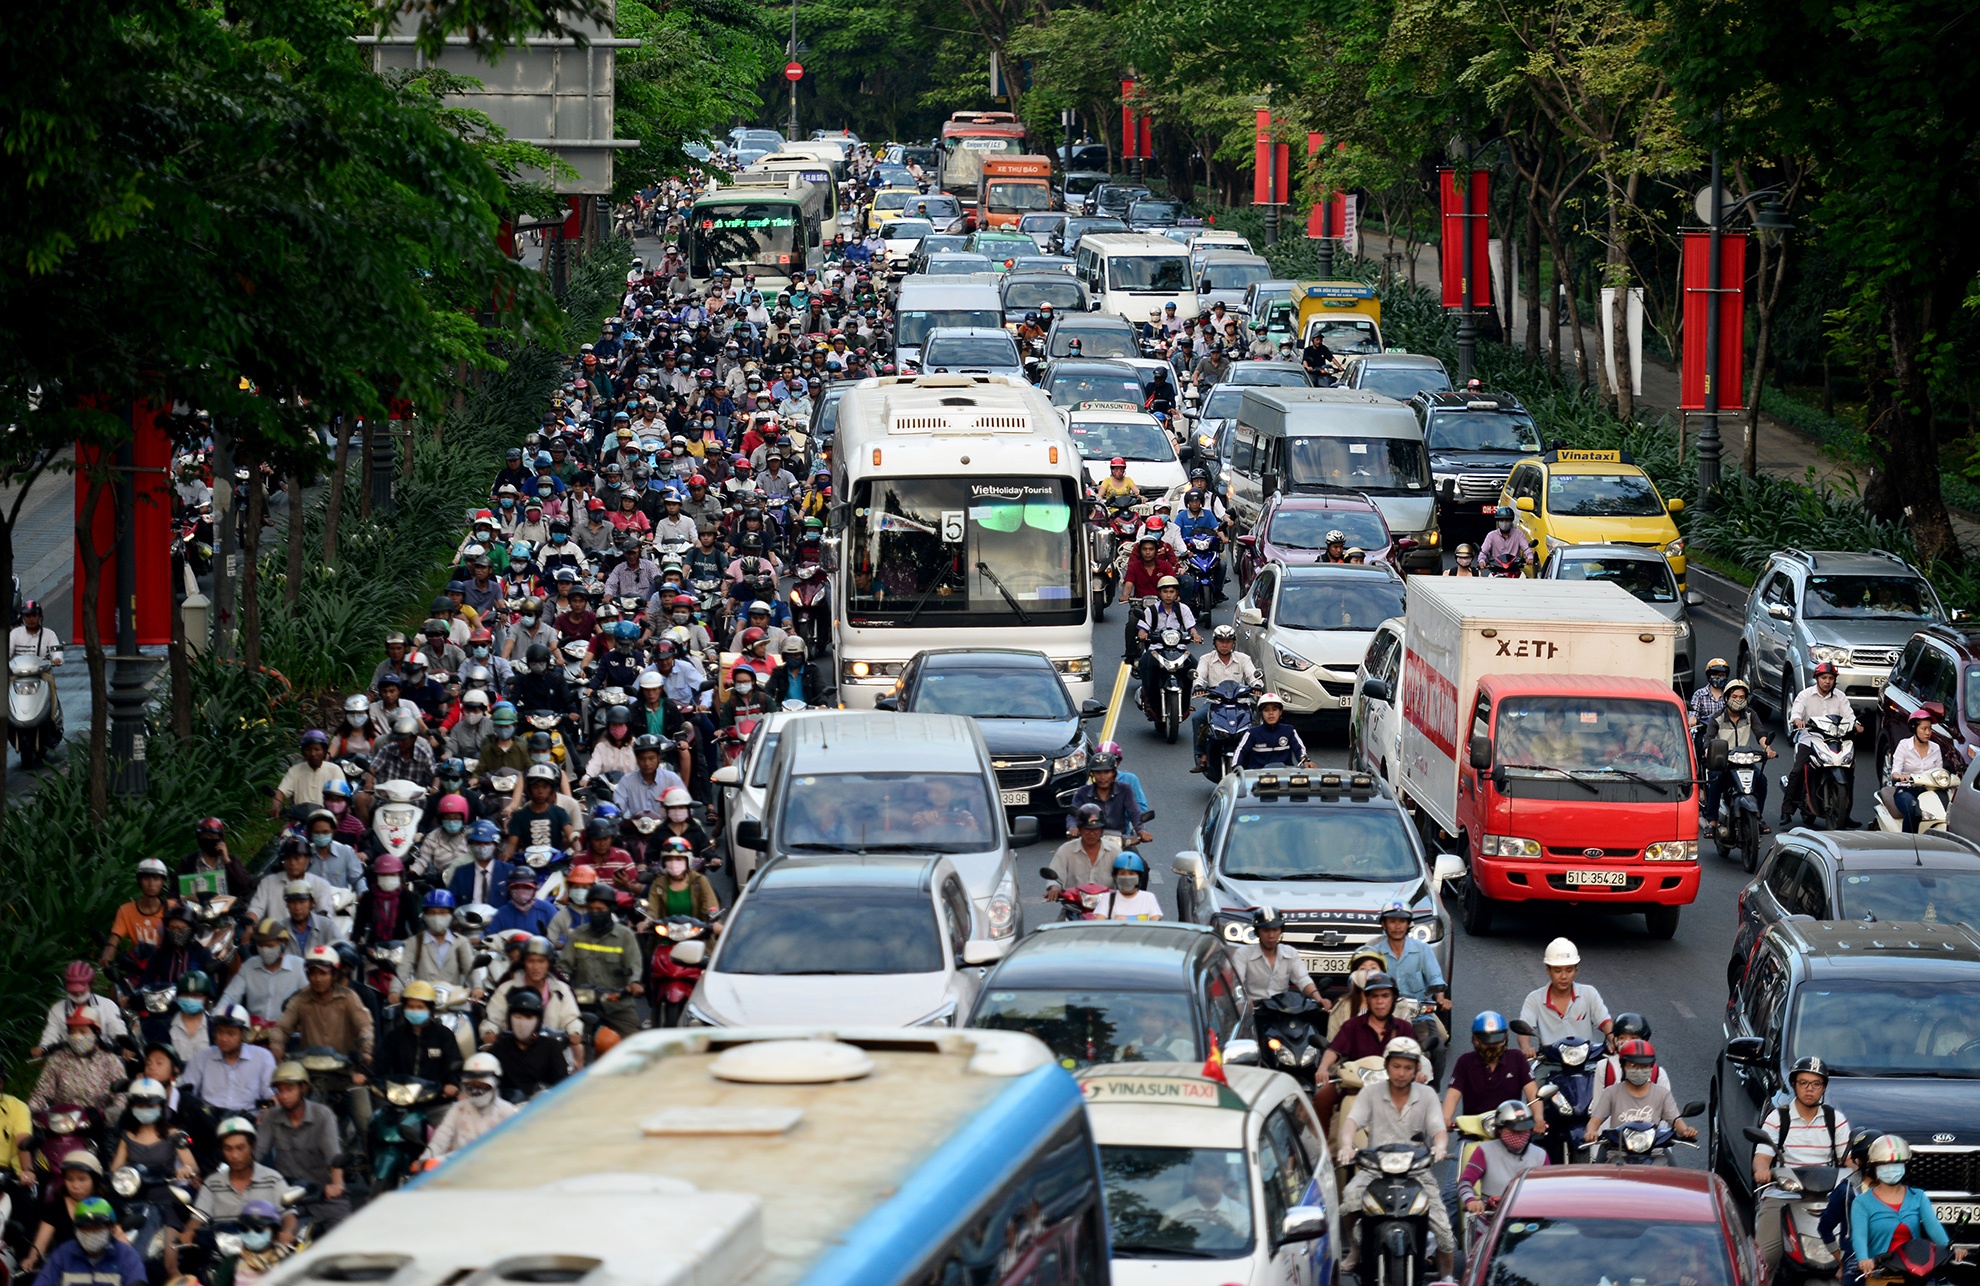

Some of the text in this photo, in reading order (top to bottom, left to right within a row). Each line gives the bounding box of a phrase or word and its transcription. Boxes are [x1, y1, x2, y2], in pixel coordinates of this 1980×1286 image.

[1094, 402, 1137, 411] VINASUN TAXI
[1561, 451, 1615, 461] Vinataxi
[946, 514, 963, 540] 5
[1341, 696, 1351, 706] 81
[1108, 1081, 1215, 1099] VINASUN TAXI
